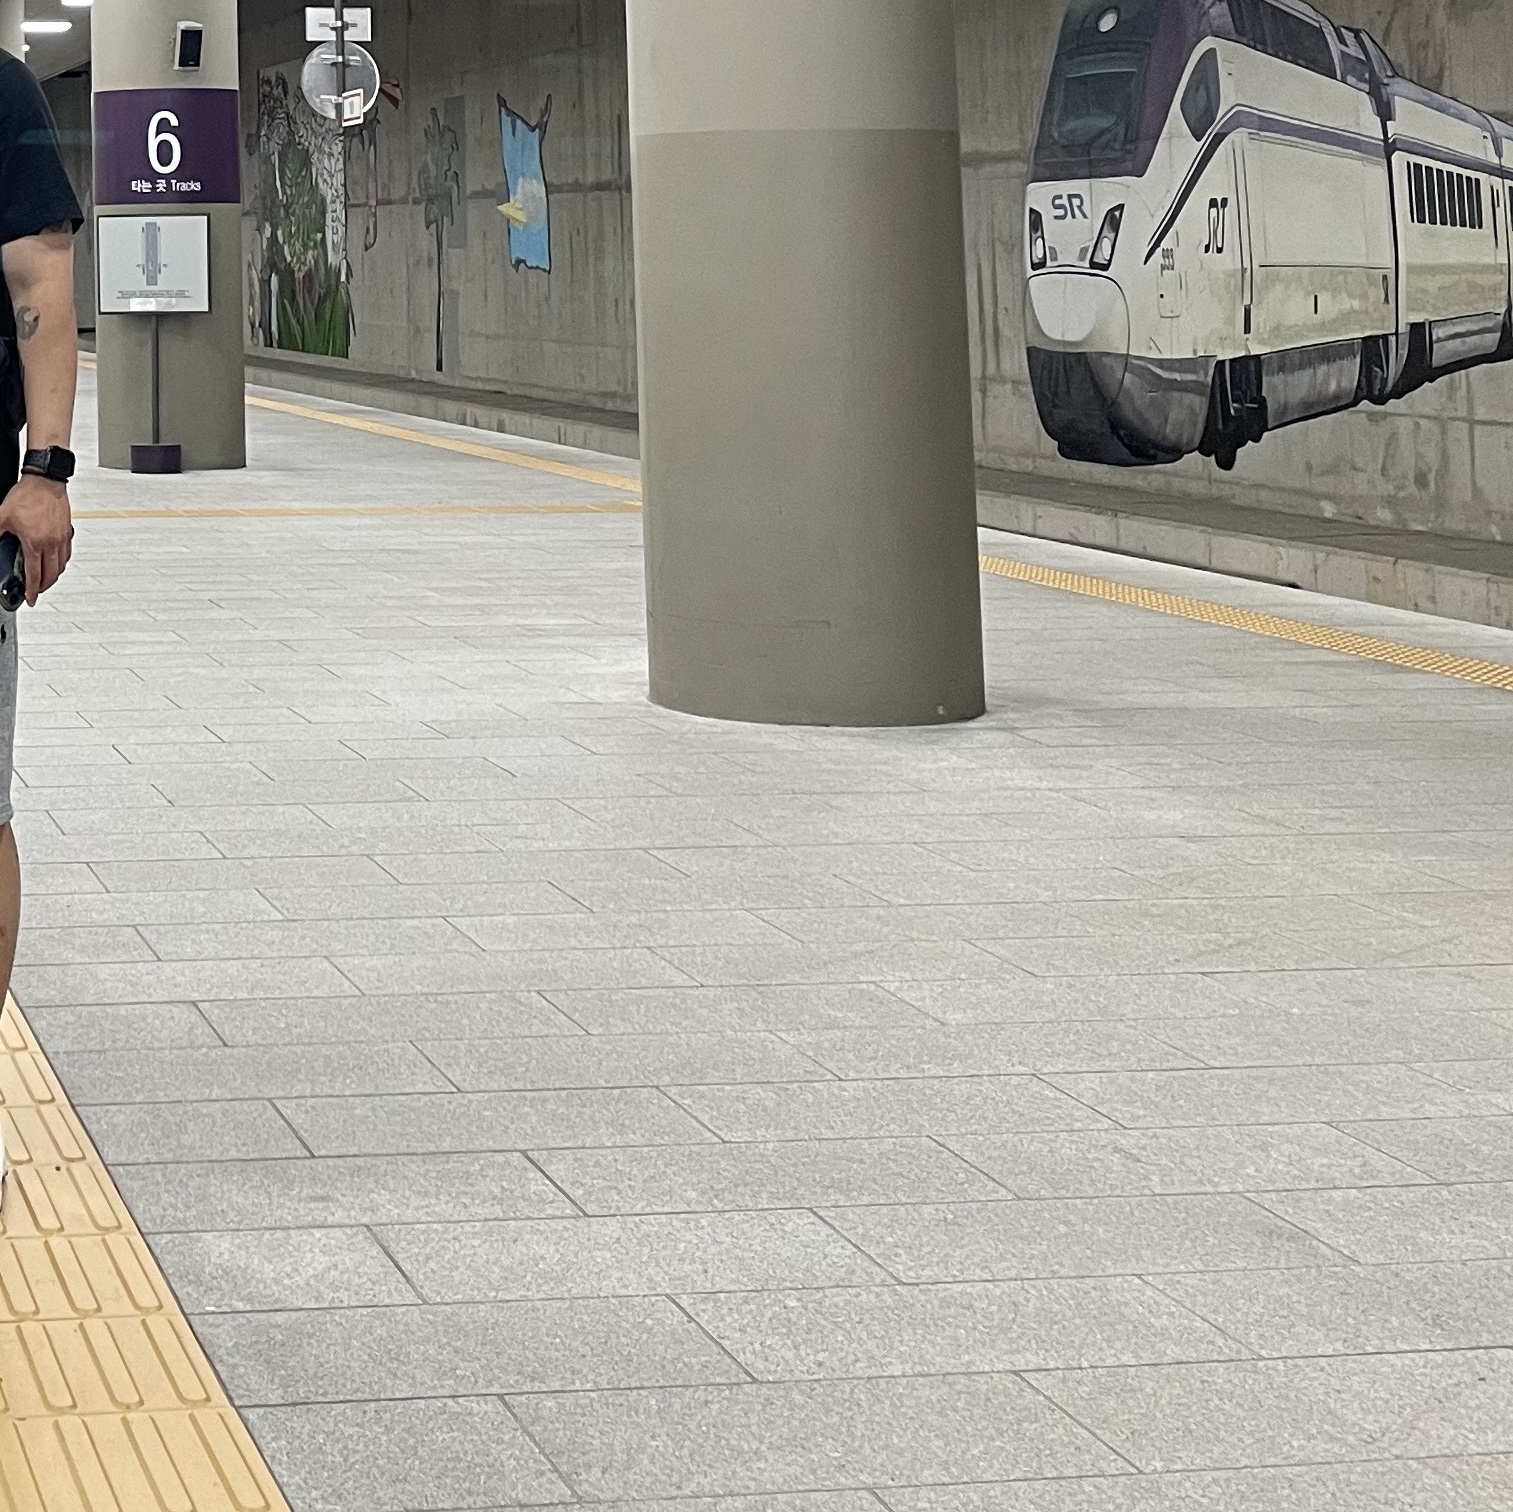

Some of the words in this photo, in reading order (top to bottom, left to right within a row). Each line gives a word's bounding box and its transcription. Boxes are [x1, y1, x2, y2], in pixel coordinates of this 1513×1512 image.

[147, 110, 182, 174] 6
[131, 179, 153, 193] 타는
[155, 179, 167, 193] 곳
[170, 179, 202, 192] Tracks
[1051, 193, 1089, 221] SR
